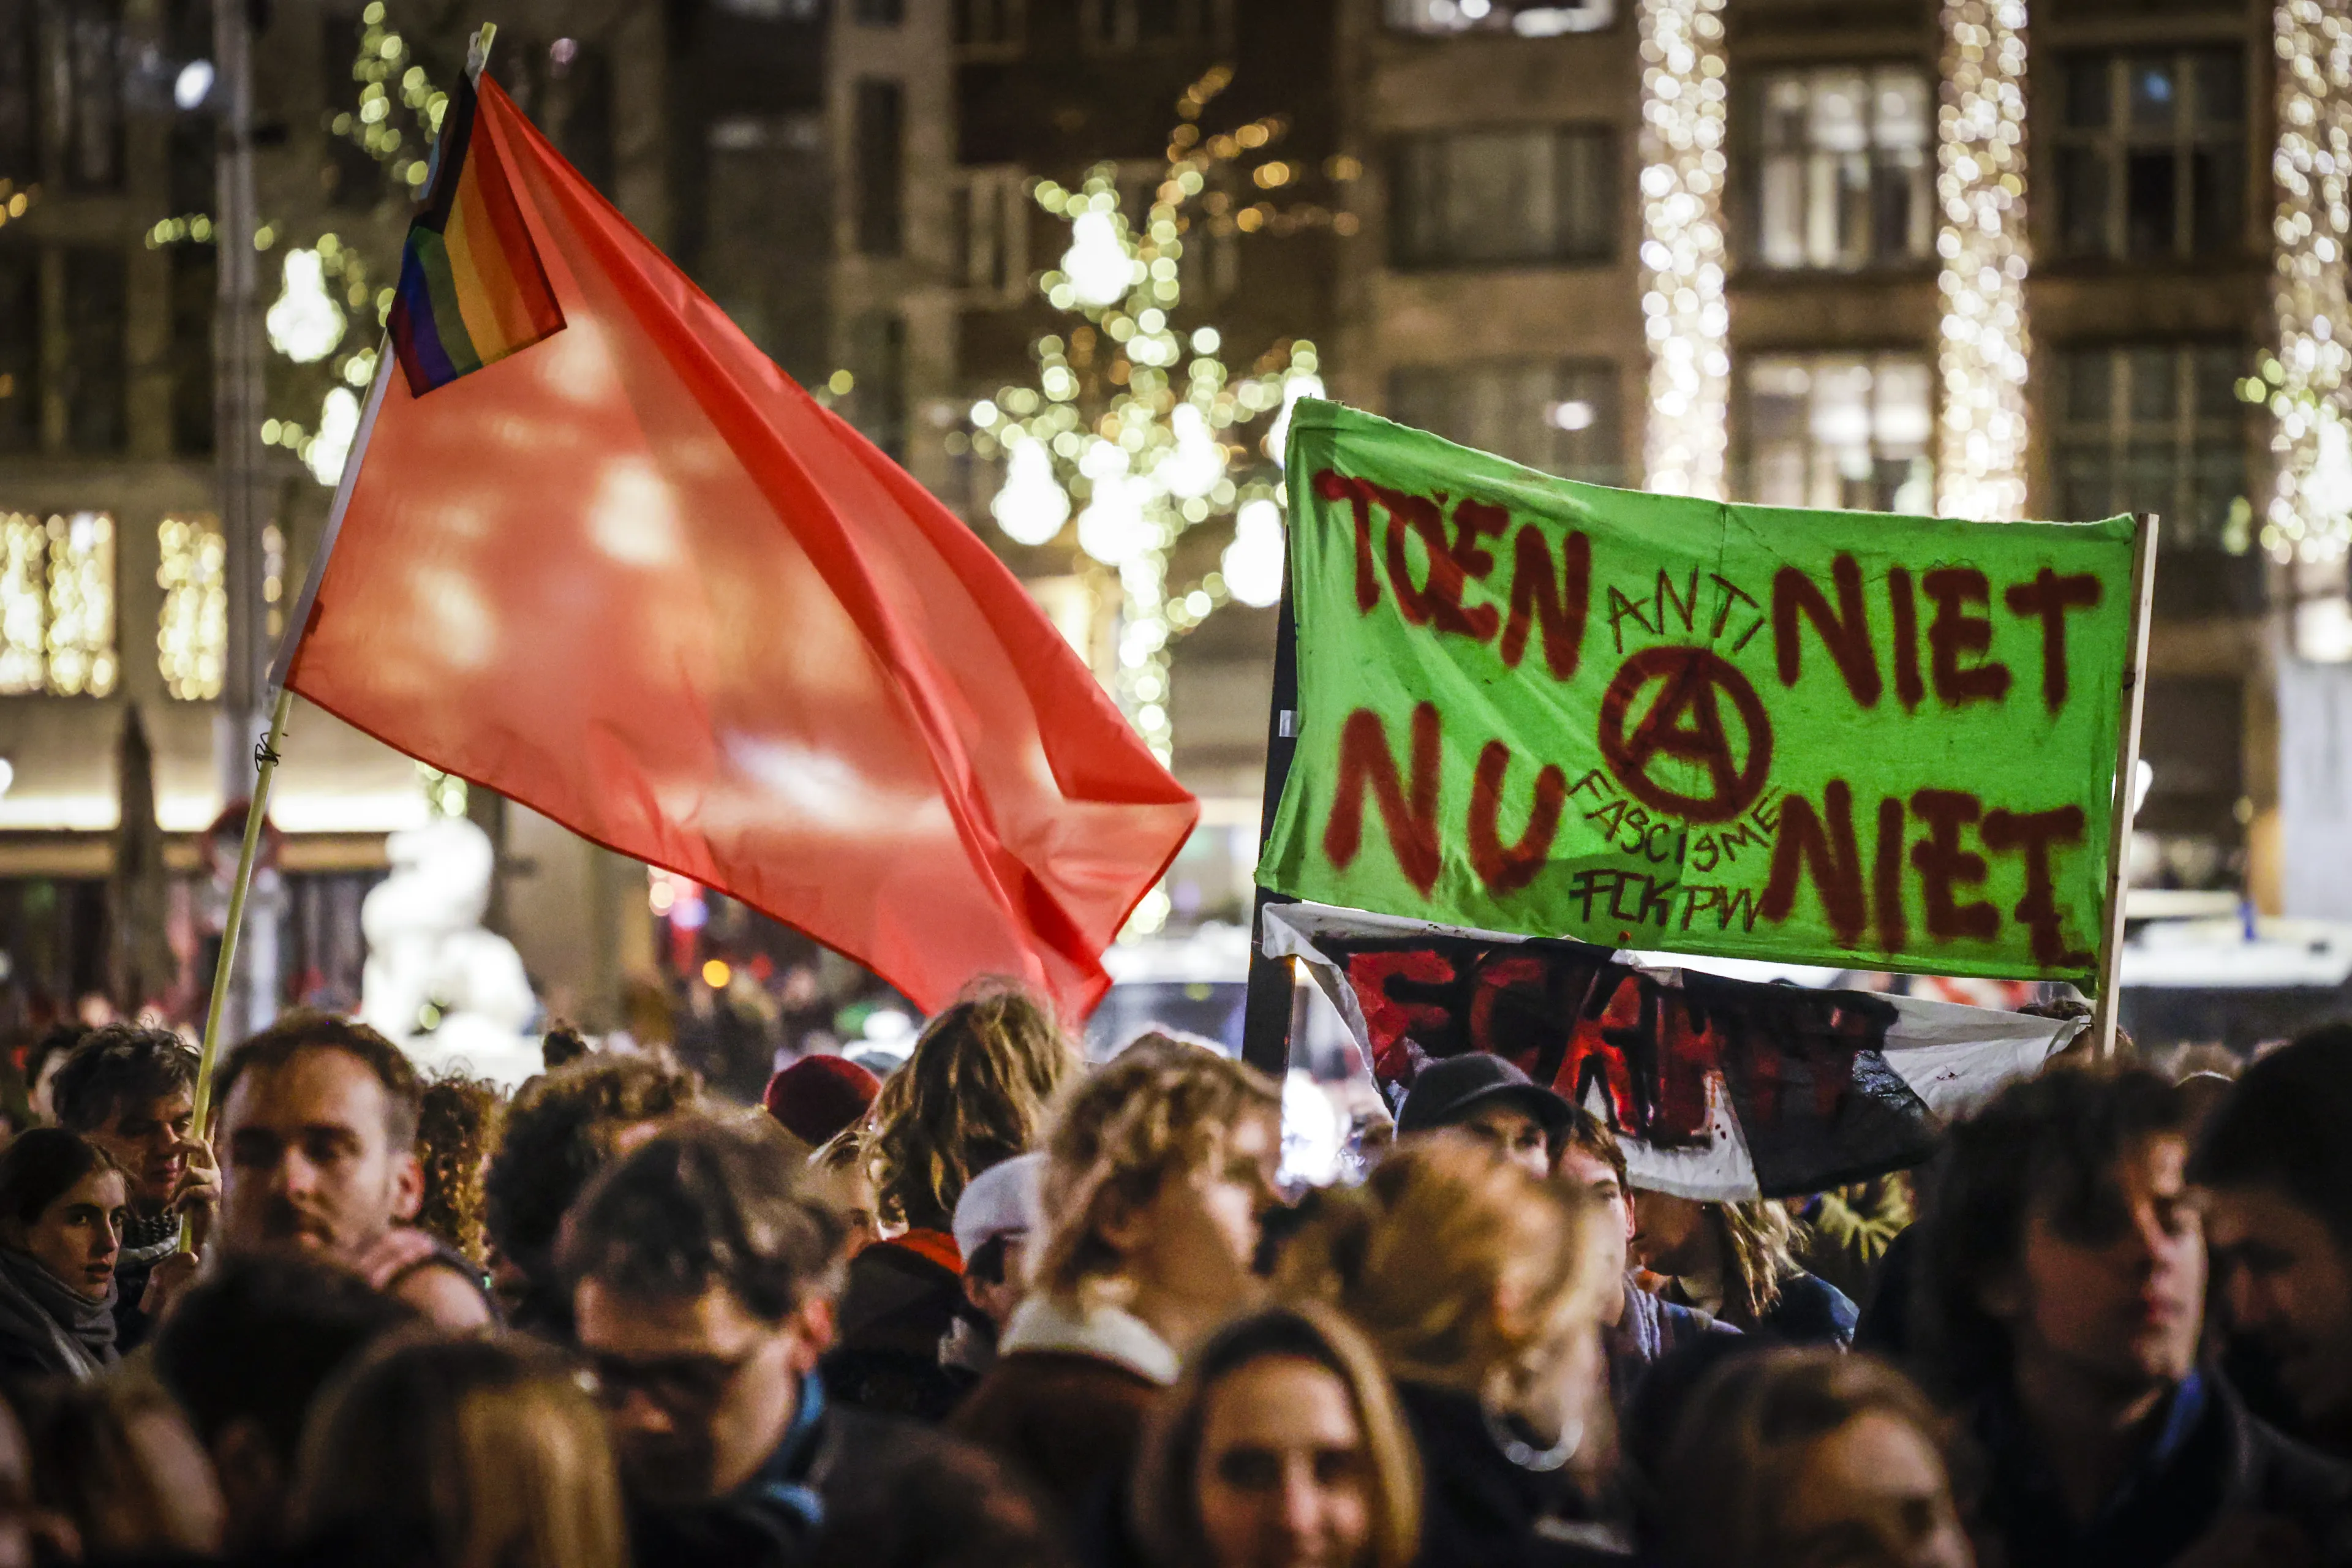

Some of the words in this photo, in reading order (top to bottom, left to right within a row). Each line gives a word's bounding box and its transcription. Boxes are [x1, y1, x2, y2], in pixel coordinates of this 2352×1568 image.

[1313, 468, 1591, 682] TOEN
[1770, 551, 2102, 718] NIET
[1607, 565, 1765, 654] ANTI
[1323, 701, 1567, 902] NU
[1763, 778, 2097, 969] NIET
[1566, 768, 1782, 872] FASCISME
